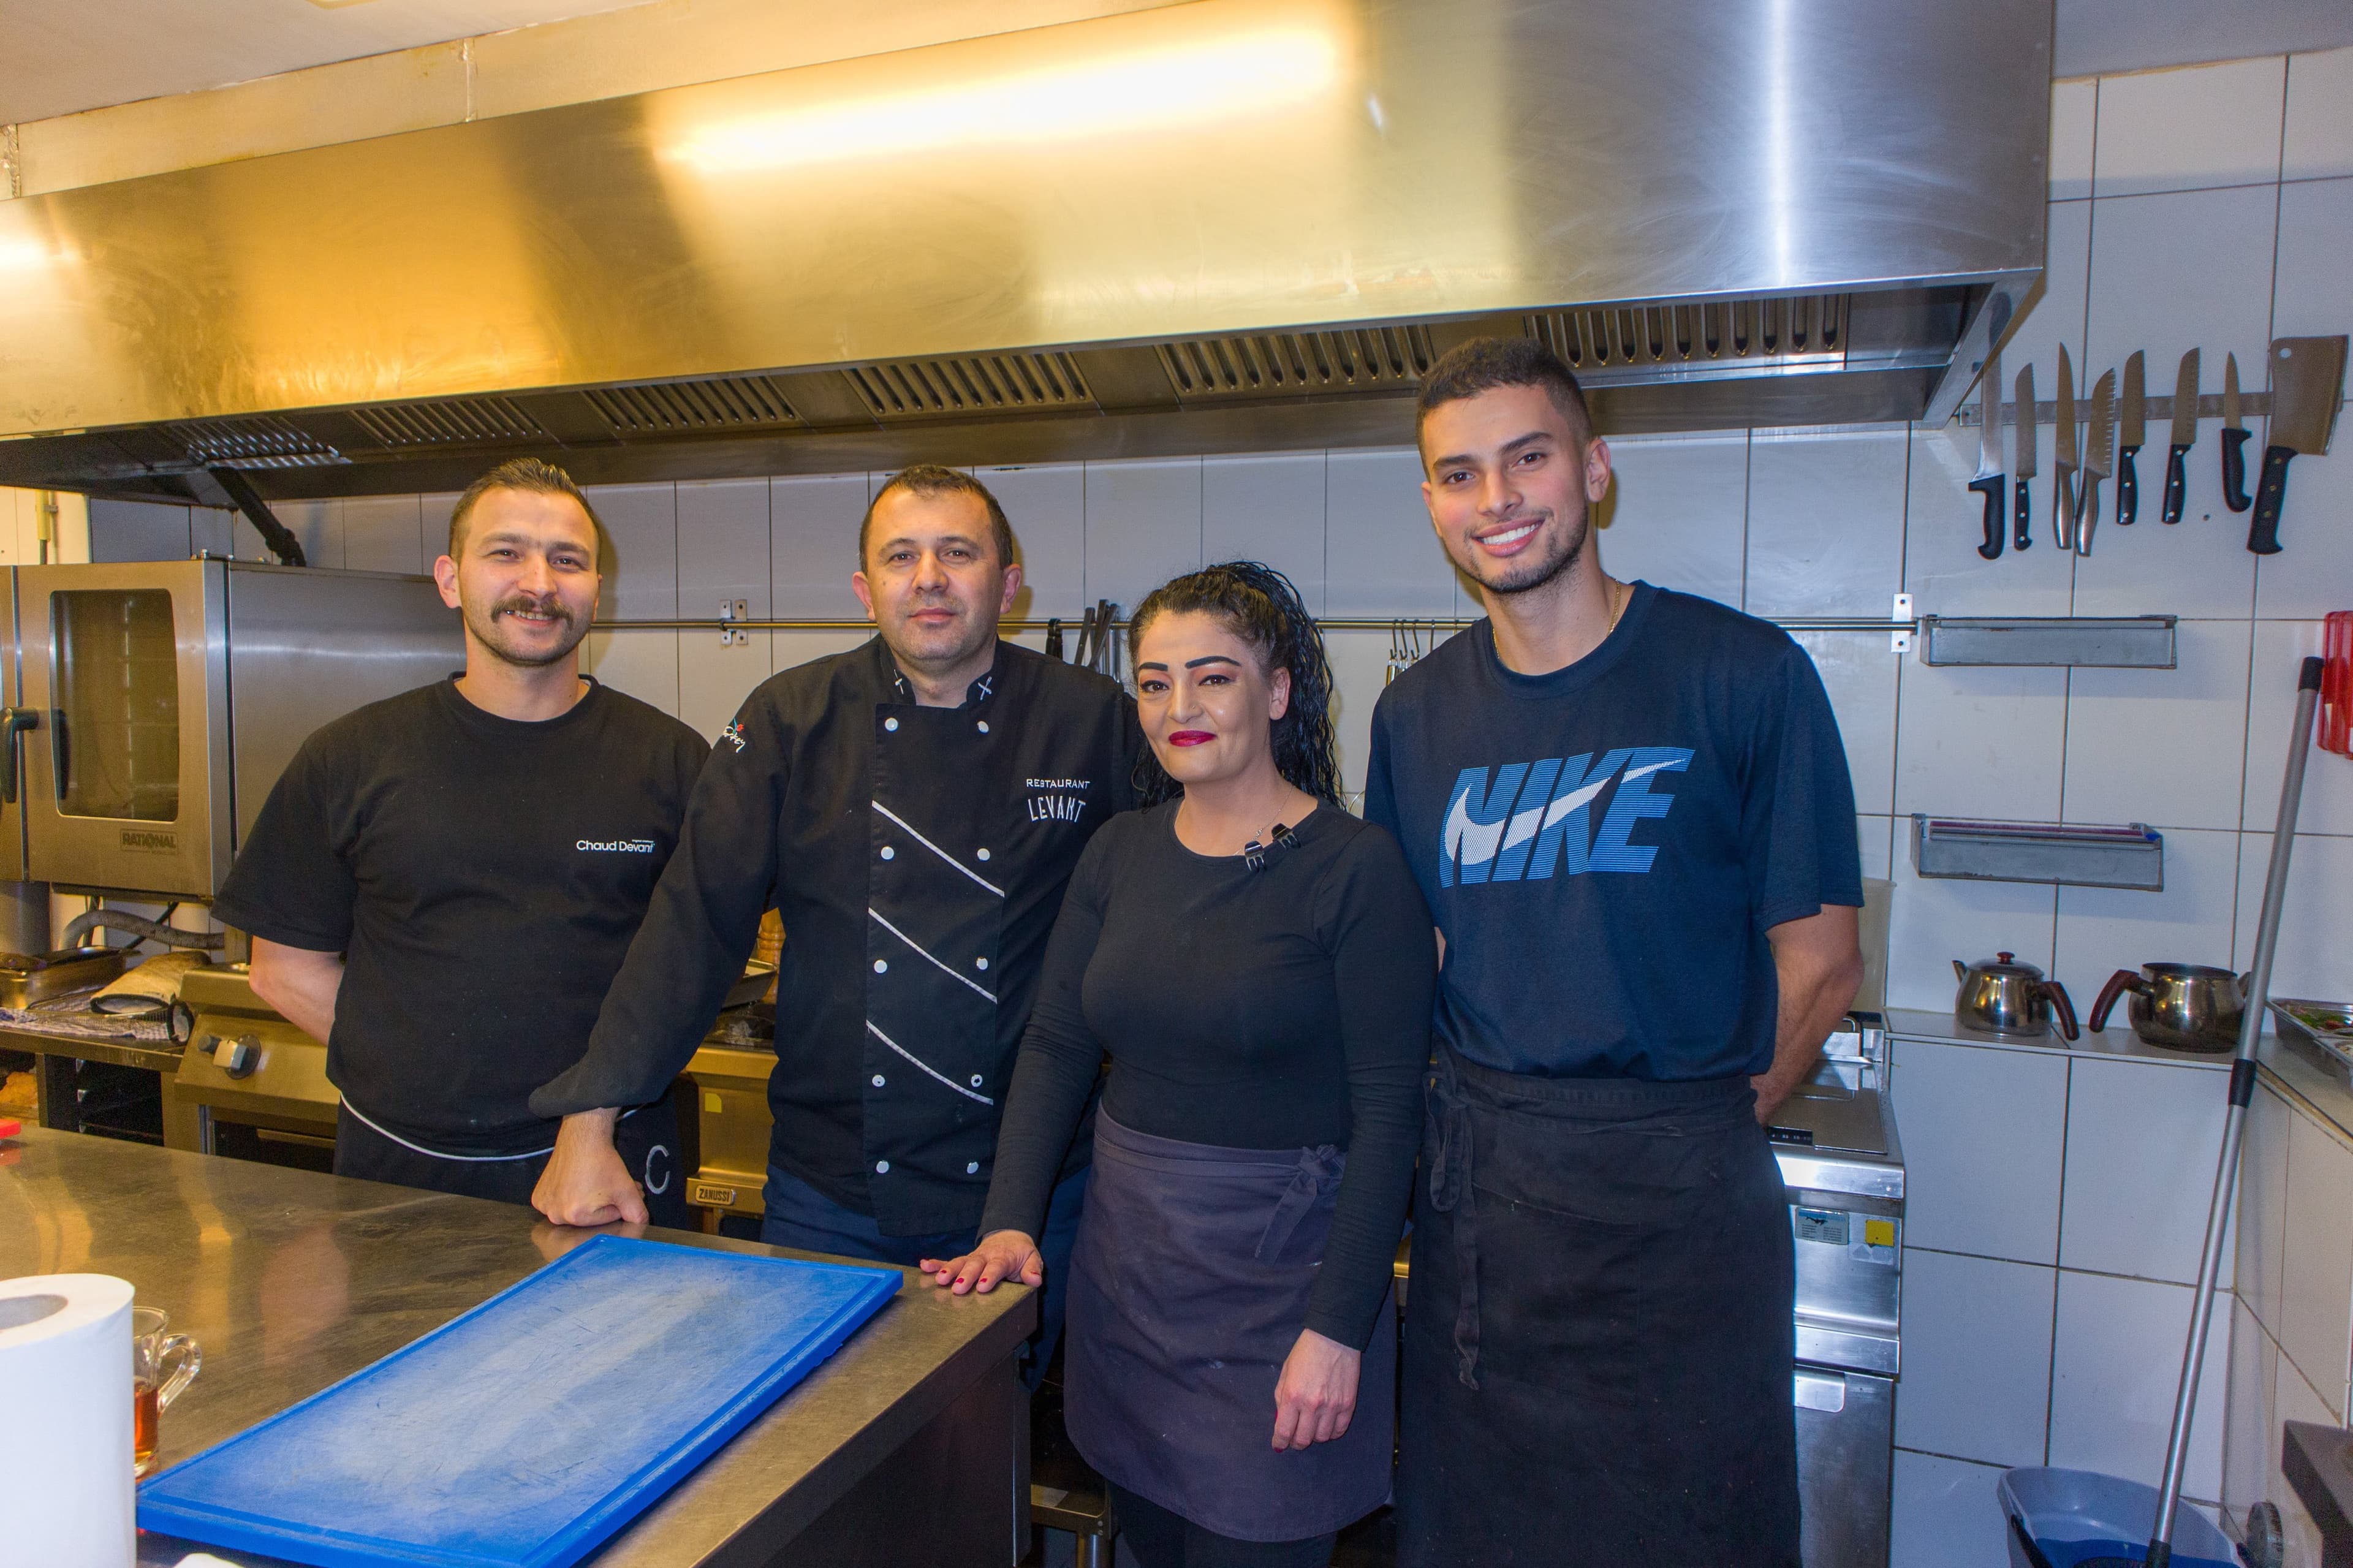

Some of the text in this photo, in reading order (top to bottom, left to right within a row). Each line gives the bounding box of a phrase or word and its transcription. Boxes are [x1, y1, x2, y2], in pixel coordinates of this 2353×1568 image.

[1026, 778, 1090, 789] RESTAURANT
[1028, 795, 1086, 822] LEVANT
[1439, 747, 1696, 888] NIKE
[577, 840, 653, 853] Chaud Devant
[699, 1188, 730, 1202] ZANUSSI
